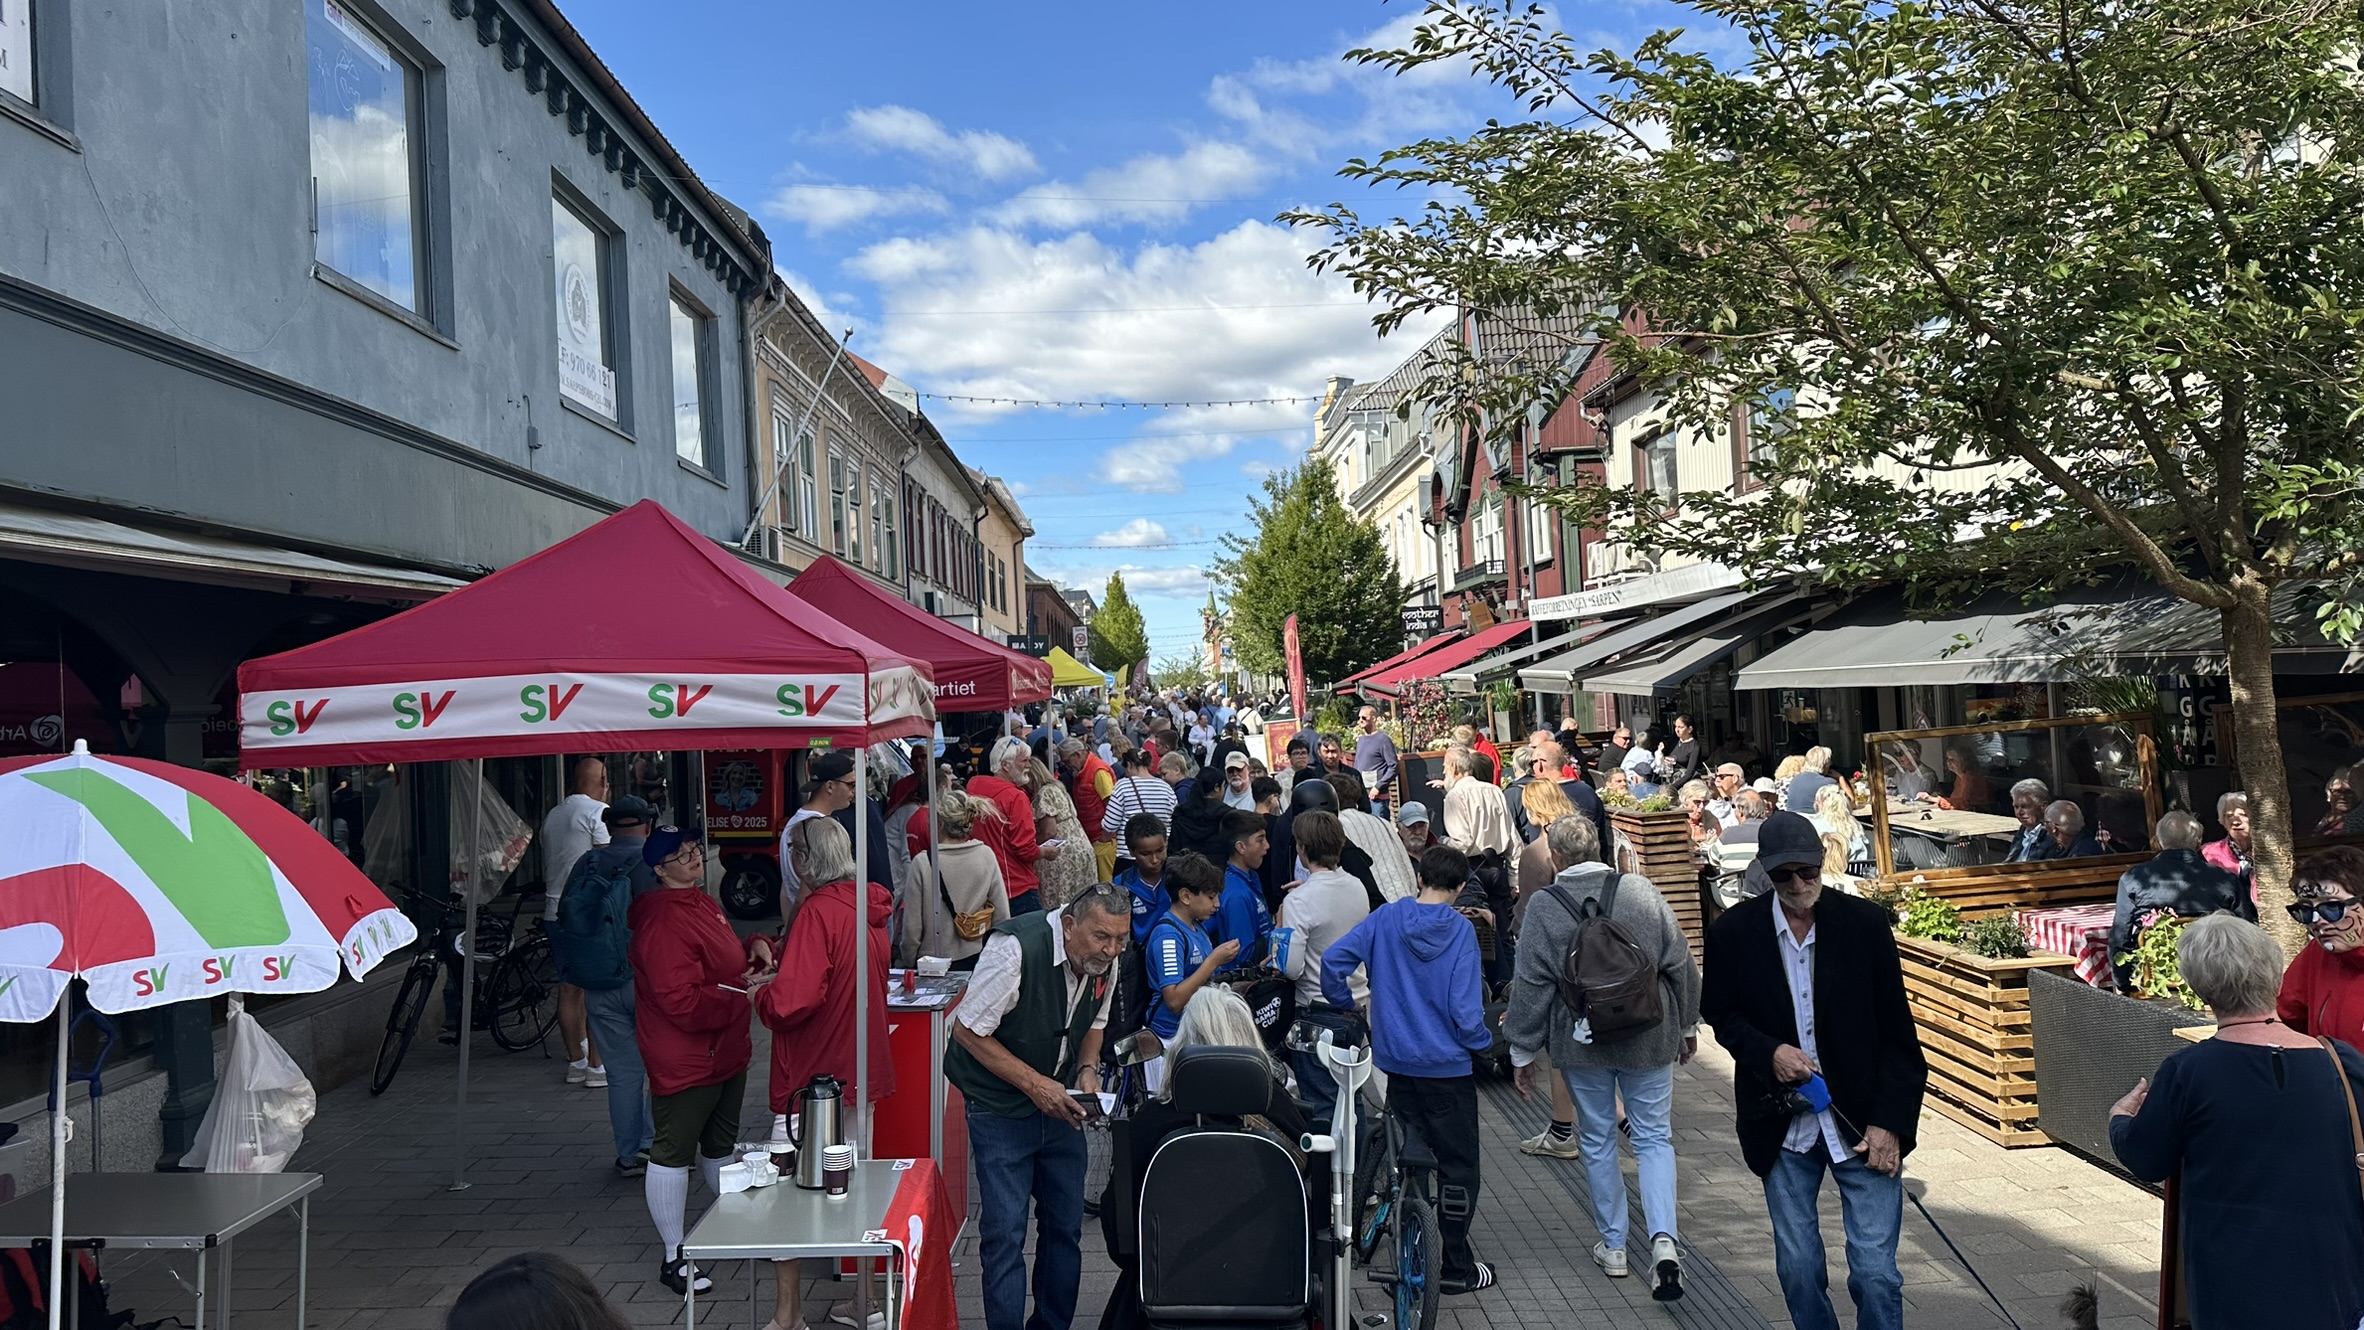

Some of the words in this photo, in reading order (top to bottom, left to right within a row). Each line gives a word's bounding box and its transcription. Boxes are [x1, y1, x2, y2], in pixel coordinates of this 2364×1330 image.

[570, 352, 585, 374] 970
[598, 369, 611, 389] 121
[1402, 607, 1439, 619] mother
[1405, 618, 1428, 630] india
[267, 698, 331, 736] SV
[392, 690, 457, 729] SV
[519, 683, 583, 723] SV
[647, 683, 714, 719] SV
[776, 683, 841, 717] SV
[706, 816, 729, 828] ELISE
[744, 816, 767, 828] 2025
[132, 962, 170, 996] SV
[202, 953, 237, 984] SV
[263, 953, 296, 981] SV
[1254, 1009, 1276, 1025] BAMA
[1256, 1002, 1273, 1017] KIWI
[1261, 1015, 1276, 1028] CUP
